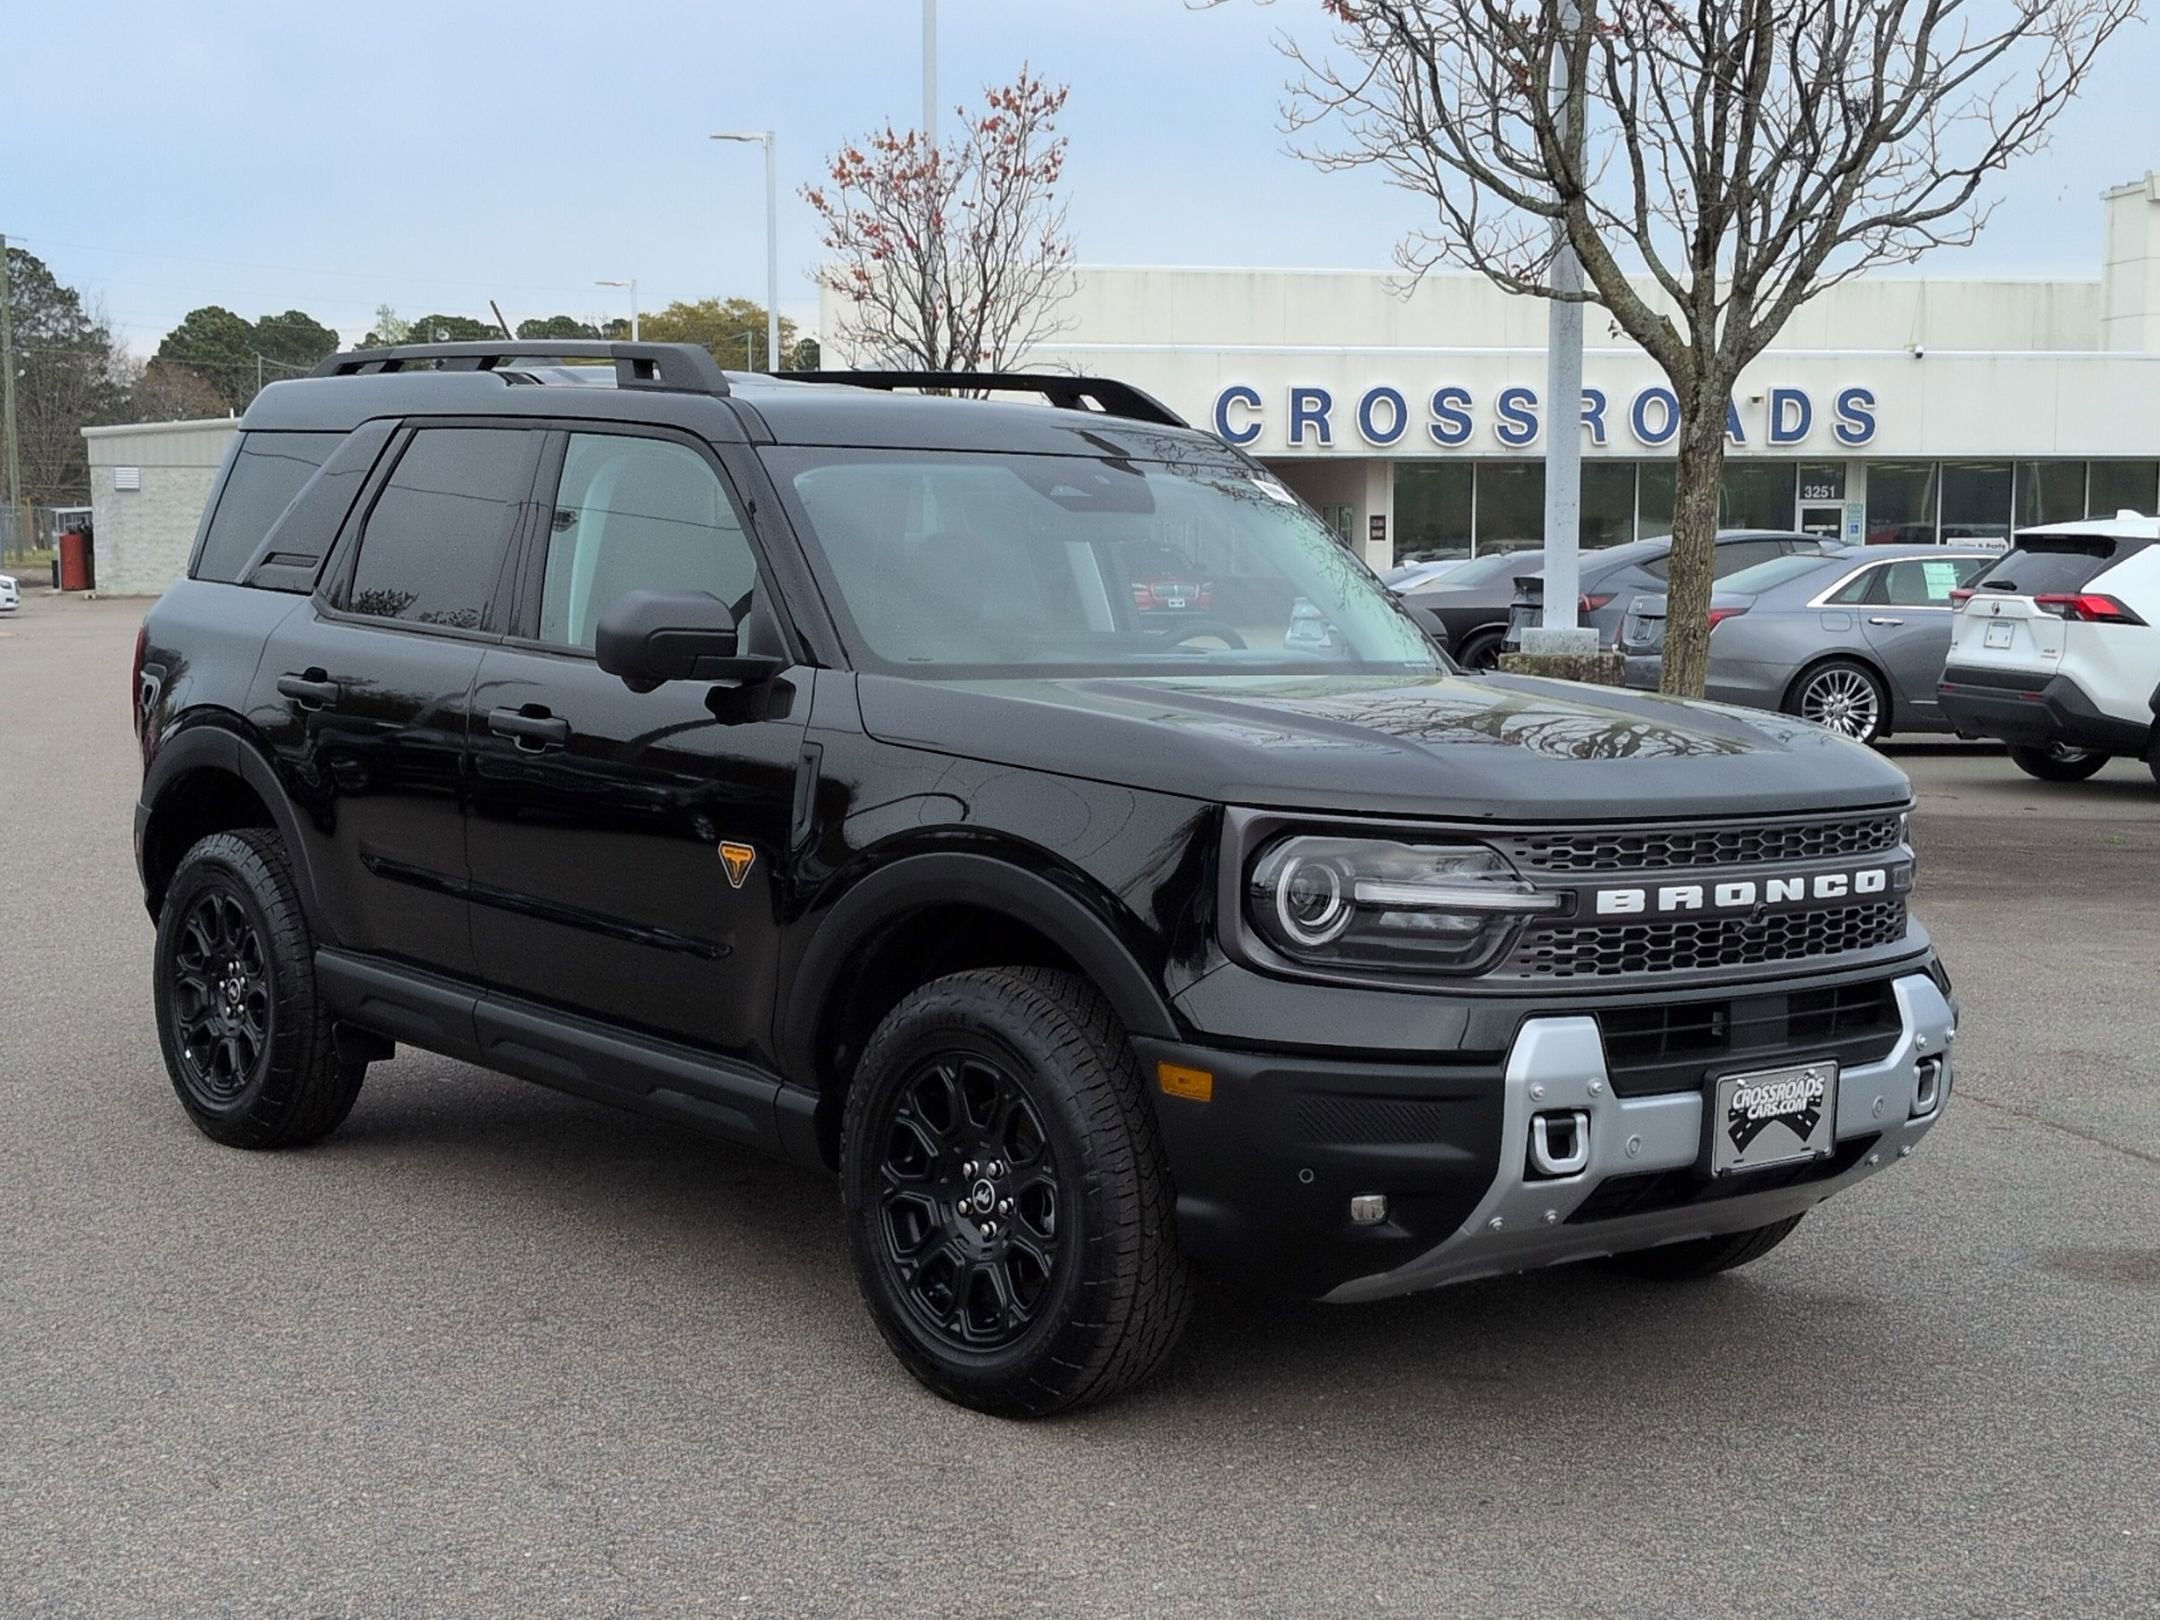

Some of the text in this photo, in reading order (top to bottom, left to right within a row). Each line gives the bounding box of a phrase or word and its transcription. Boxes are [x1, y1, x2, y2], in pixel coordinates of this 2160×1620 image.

[1804, 485, 1835, 498] 3251
[1597, 870, 1886, 914] BRONCO
[1732, 1076, 1825, 1110] CROSSROADS
[1747, 1097, 1808, 1120] CARS.COM
